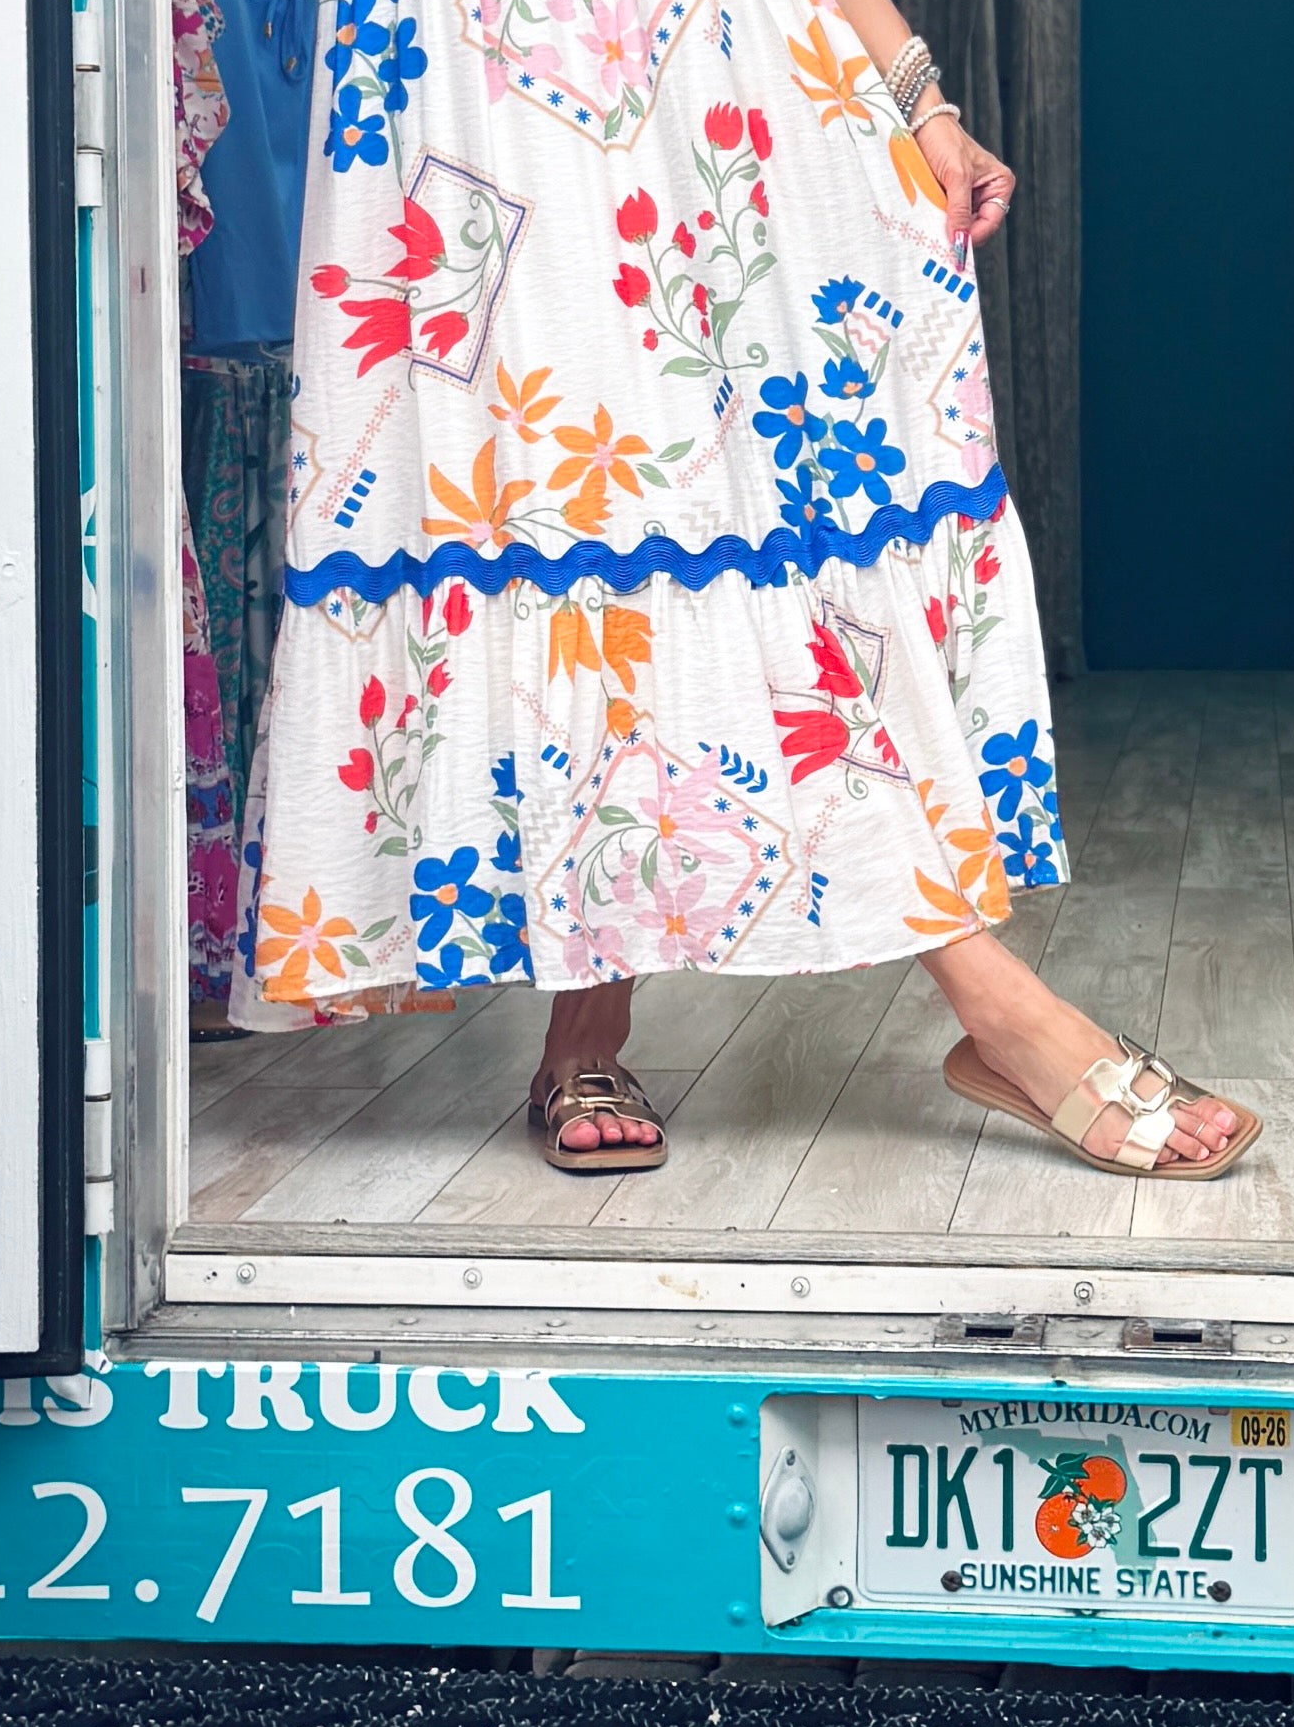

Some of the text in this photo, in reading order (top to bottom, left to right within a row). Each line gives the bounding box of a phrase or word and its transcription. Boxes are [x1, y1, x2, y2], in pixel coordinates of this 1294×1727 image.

[146, 1361, 586, 1434] TRUCK
[959, 1400, 1212, 1443] MYFLORIDA.COM
[886, 1444, 1283, 1563] DK1 2ZT
[960, 1562, 1208, 1600] SUNSHINE STATE
